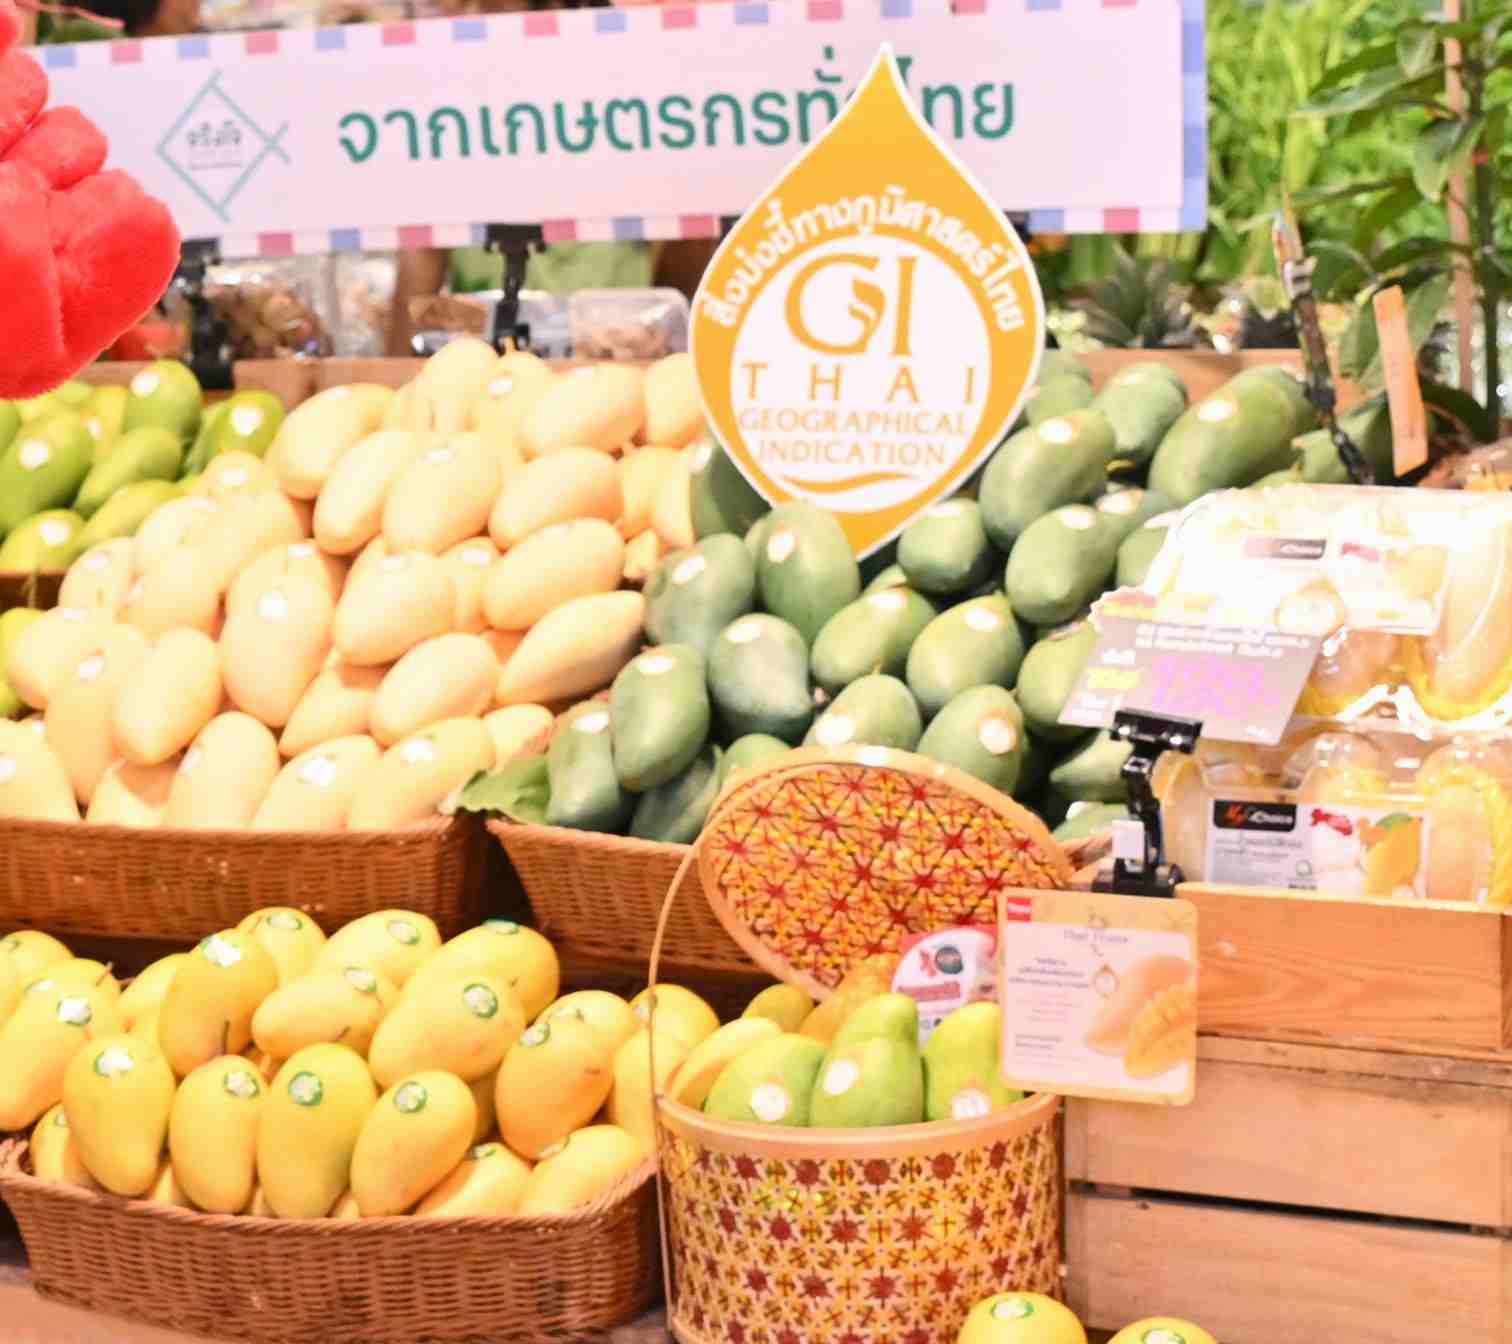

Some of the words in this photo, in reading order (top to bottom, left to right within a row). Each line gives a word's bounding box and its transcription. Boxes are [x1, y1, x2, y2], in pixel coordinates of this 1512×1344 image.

[339, 45, 1017, 164] จากเกษตรกรทั่ทย
[784, 252, 918, 356] GI
[742, 362, 975, 405] THAI
[738, 407, 970, 438] GEOGRAPHICAL
[758, 439, 946, 467] INDICATION
